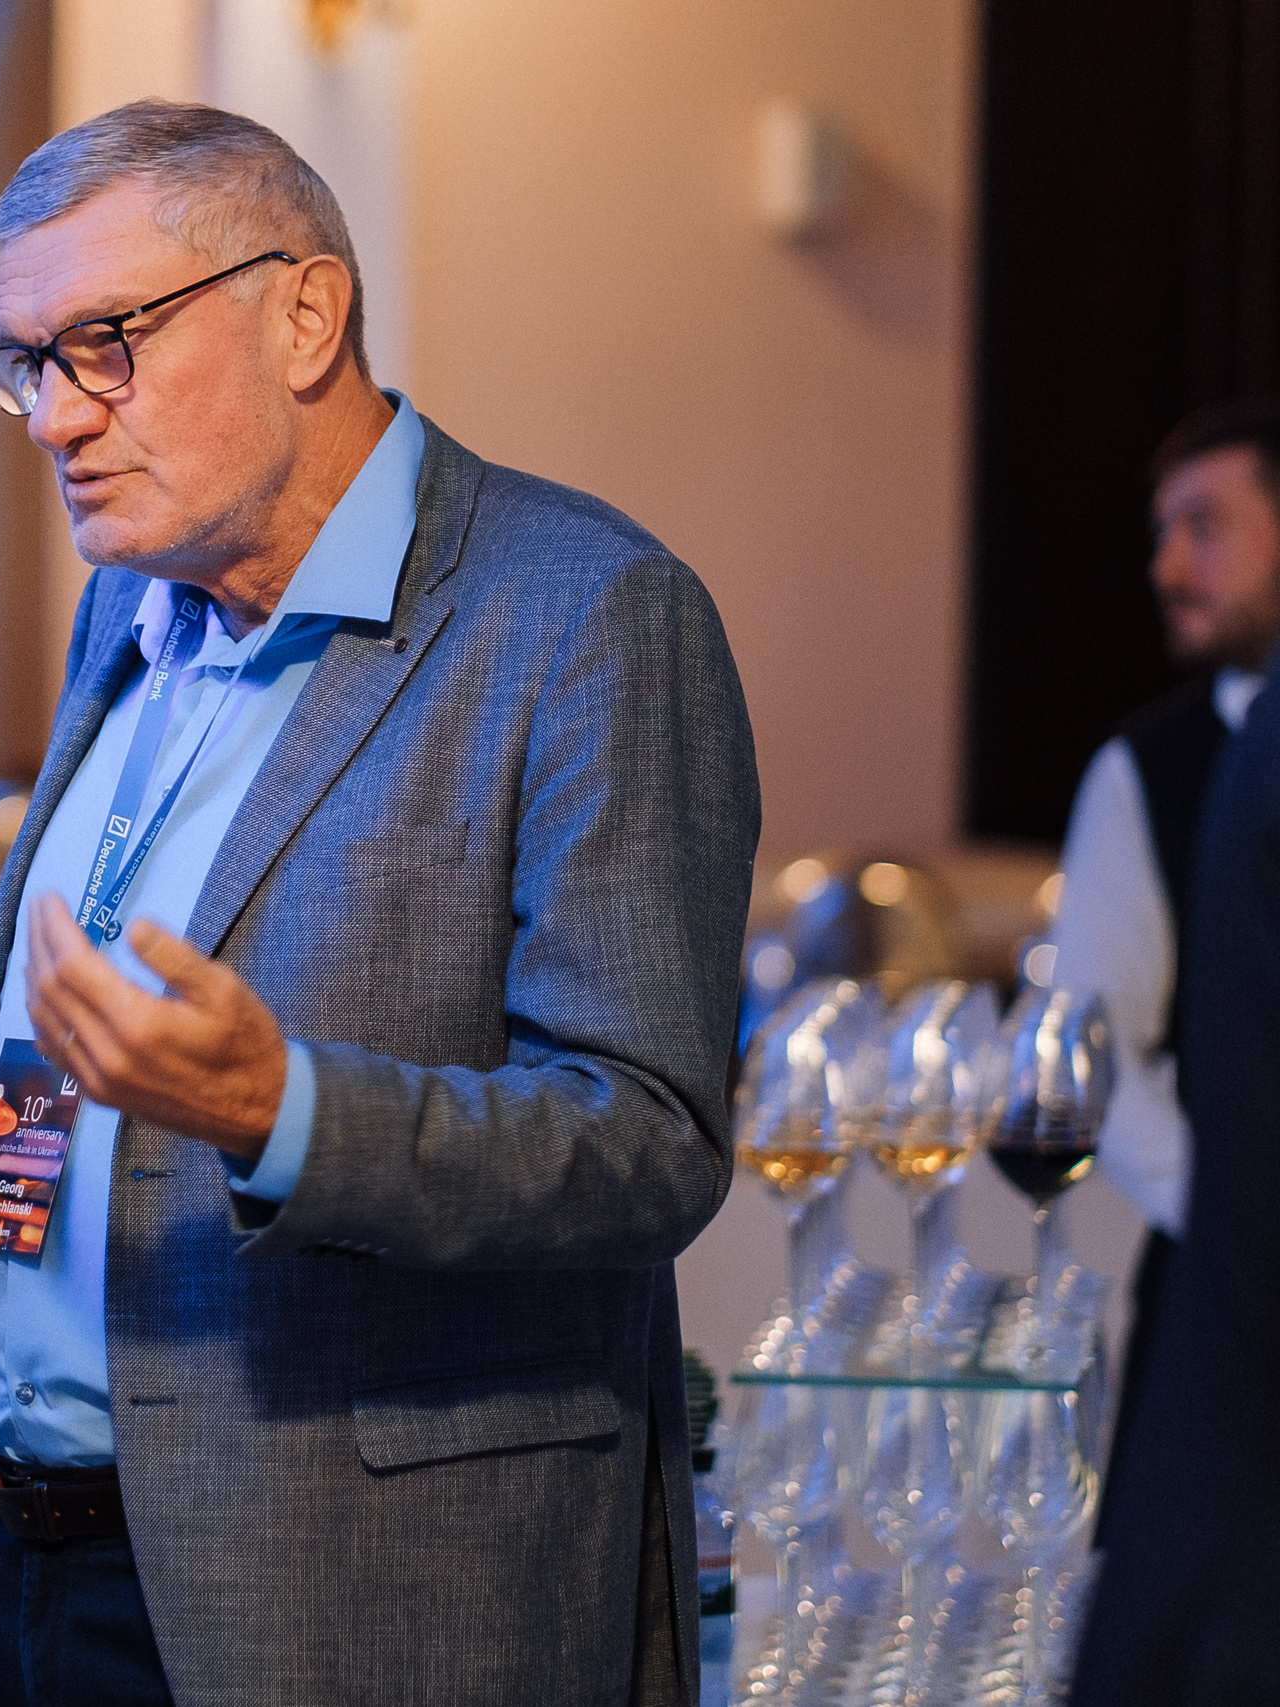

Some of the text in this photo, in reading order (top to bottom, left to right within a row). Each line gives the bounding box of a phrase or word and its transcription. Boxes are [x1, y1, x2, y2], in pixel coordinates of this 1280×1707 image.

[148, 618, 187, 701] Deutsche Bank
[79, 838, 116, 928] Deutsche Bank
[111, 816, 165, 903] Deutsche Bank
[15, 1126, 65, 1144] anniversary
[20, 1095, 53, 1122] 10th
[17, 1144, 31, 1154] Bank
[31, 1145, 38, 1154] in
[38, 1146, 60, 1157] Ukraine
